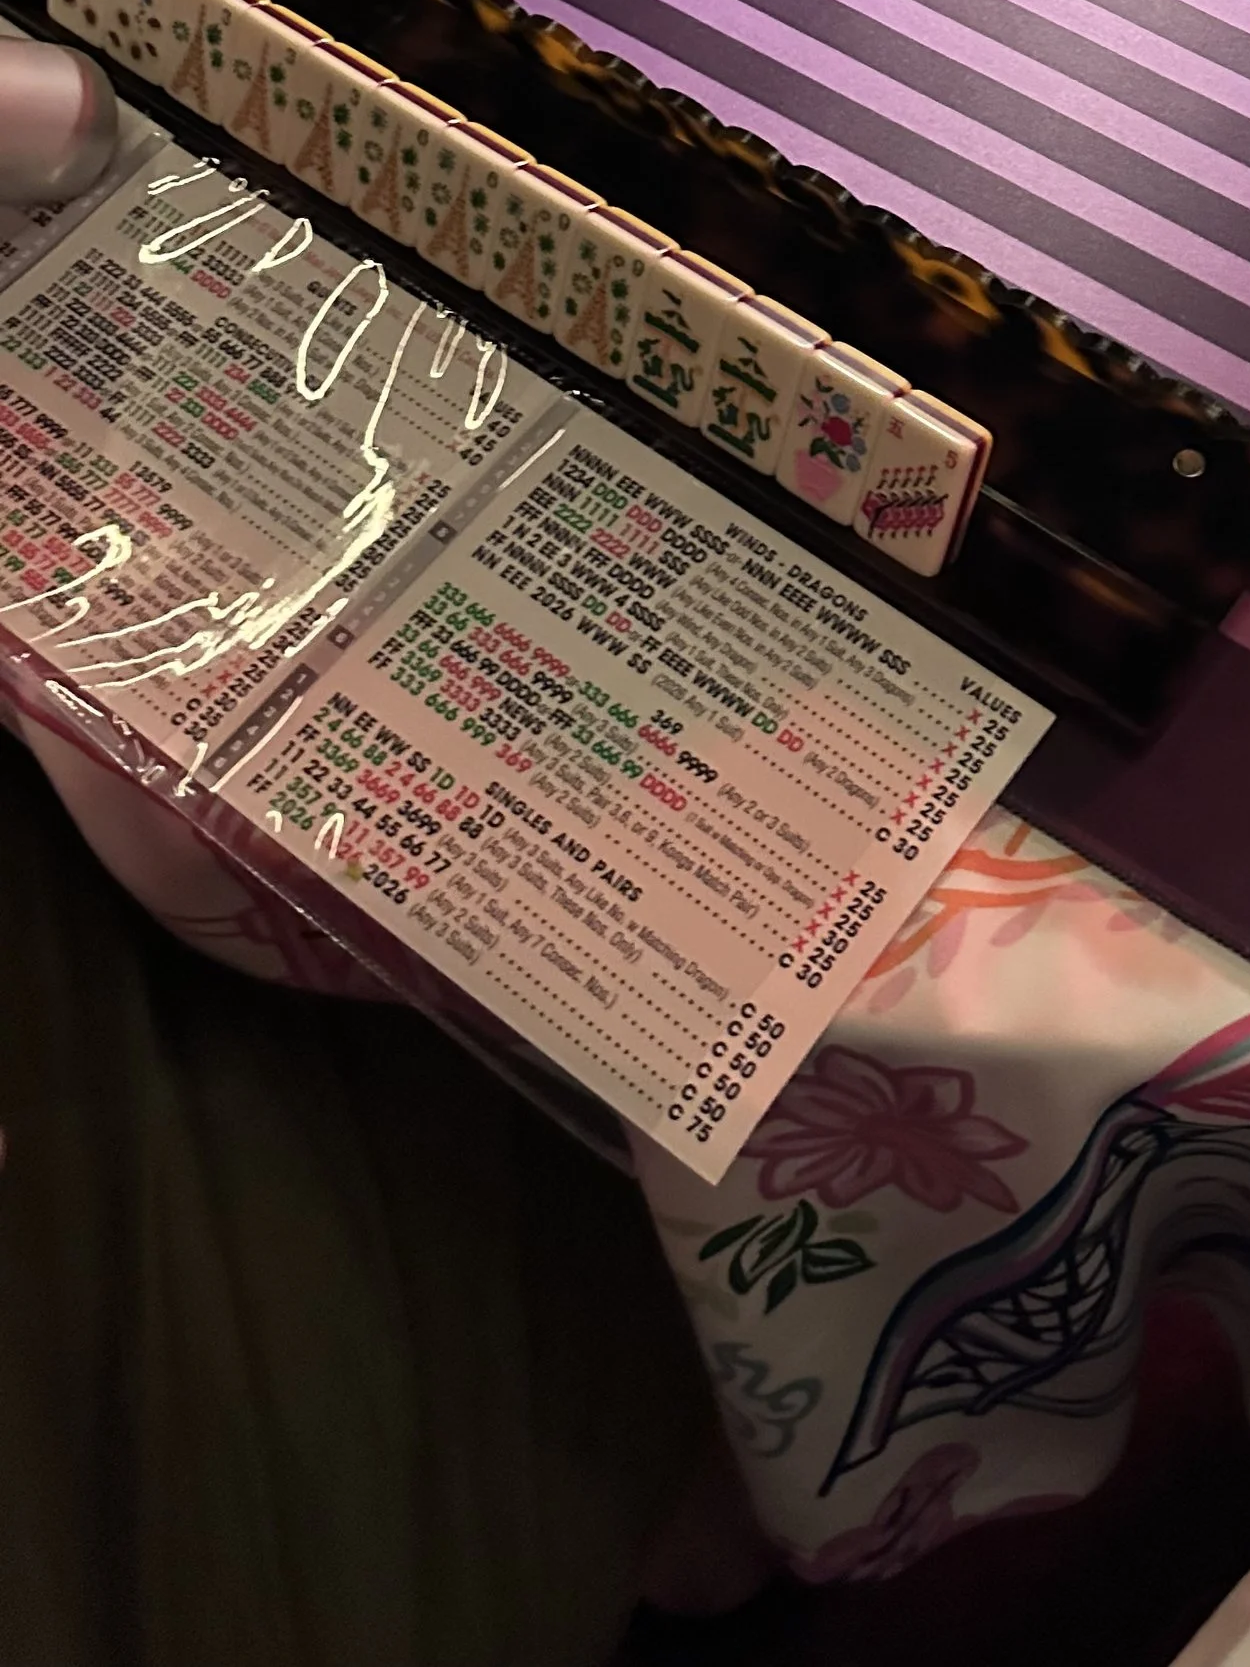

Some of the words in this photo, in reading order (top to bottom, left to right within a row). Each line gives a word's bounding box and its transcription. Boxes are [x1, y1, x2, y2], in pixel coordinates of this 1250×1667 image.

[138, 285, 168, 305] 444
[240, 354, 264, 372] 77
[208, 315, 308, 379] CONSECUTIV
[97, 405, 123, 424] 44
[179, 441, 217, 469] 3333
[456, 445, 485, 467] 40
[470, 432, 499, 453] 45
[484, 418, 512, 438] 40
[944, 450, 958, 469] 5
[127, 460, 174, 495] 13579
[555, 457, 596, 489] 1234
[590, 481, 629, 511] DDD
[624, 504, 664, 535] DDD
[658, 526, 709, 565] DDDD
[567, 443, 619, 482] NNNN
[614, 474, 646, 500] EEE
[641, 492, 693, 531] WWW
[688, 523, 730, 556] SSSS
[740, 557, 781, 590] NNN
[778, 582, 817, 614] EEEE
[813, 605, 882, 657] WWWW
[877, 647, 912, 677] SSS
[965, 706, 984, 725] X
[981, 716, 1010, 742] 25
[723, 522, 778, 563] WINDS
[786, 564, 869, 623] DRAGONS
[421, 593, 449, 617] 33
[443, 609, 472, 633] 66
[465, 624, 502, 655] 333
[496, 646, 534, 678] 666
[527, 669, 575, 708] 9999
[957, 676, 1023, 725] VALUES
[435, 579, 469, 607] 333
[463, 599, 497, 627] 666
[491, 619, 534, 654] 6666
[527, 645, 571, 680] 9999
[576, 679, 611, 708] 333
[605, 700, 641, 730] 666
[635, 721, 680, 758] 6666
[673, 748, 719, 786] 9999
[842, 867, 861, 887] X
[858, 878, 887, 905] 25
[470, 544, 501, 569] NN
[499, 564, 533, 591] EEE
[529, 585, 577, 622] 2026
[573, 615, 628, 658] WWW
[624, 651, 652, 675] SS
[872, 824, 892, 844] C
[890, 836, 919, 863] 30
[649, 707, 684, 737] 369
[278, 739, 306, 764] 11
[301, 757, 331, 784] 22
[325, 775, 355, 802] 33
[348, 793, 379, 821] 44
[373, 812, 403, 839] 55
[397, 831, 428, 859] 66
[422, 850, 451, 877] 77
[295, 722, 321, 745] FF
[314, 736, 361, 776] 3369
[354, 767, 401, 808] 3669
[394, 798, 443, 840] 3699
[367, 649, 393, 672] FF
[388, 665, 426, 697] 333
[422, 690, 462, 723] 666
[457, 716, 497, 749] 999
[492, 742, 533, 776] 369
[774, 950, 796, 971] C
[792, 963, 823, 992] 30
[326, 690, 358, 717] NN
[352, 709, 378, 733] EE
[372, 724, 412, 758] WW
[404, 749, 433, 774] SS
[426, 765, 457, 793] 1D
[452, 784, 482, 812] 1D
[476, 803, 507, 831] 1D
[737, 999, 759, 1022] C
[755, 1012, 787, 1043] 50
[483, 779, 553, 836] SINGLES
[549, 829, 592, 866] AND
[589, 858, 644, 905] PAIRS
[246, 772, 273, 796] FF
[268, 789, 317, 832] 2026
[360, 862, 411, 906] 2026
[664, 1100, 686, 1124] C
[682, 1115, 714, 1146] 75
